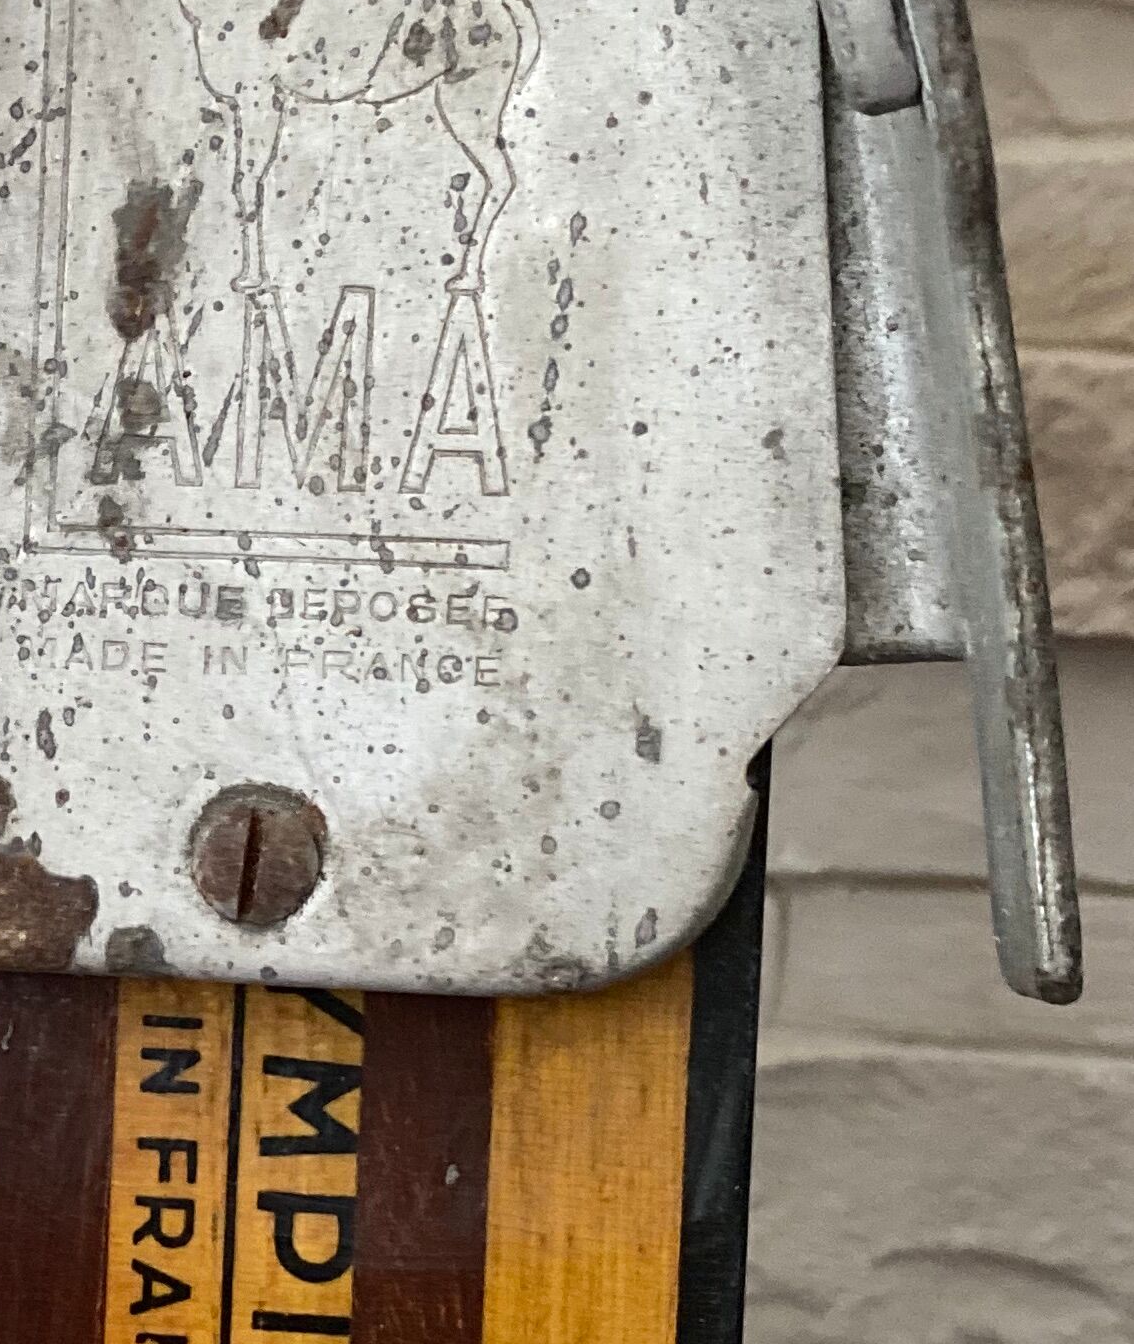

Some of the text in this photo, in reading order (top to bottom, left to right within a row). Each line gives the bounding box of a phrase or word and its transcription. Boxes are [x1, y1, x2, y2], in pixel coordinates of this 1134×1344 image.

[19, 636, 502, 687] MADE IN FRANCE
[139, 1013, 204, 1096] IN
